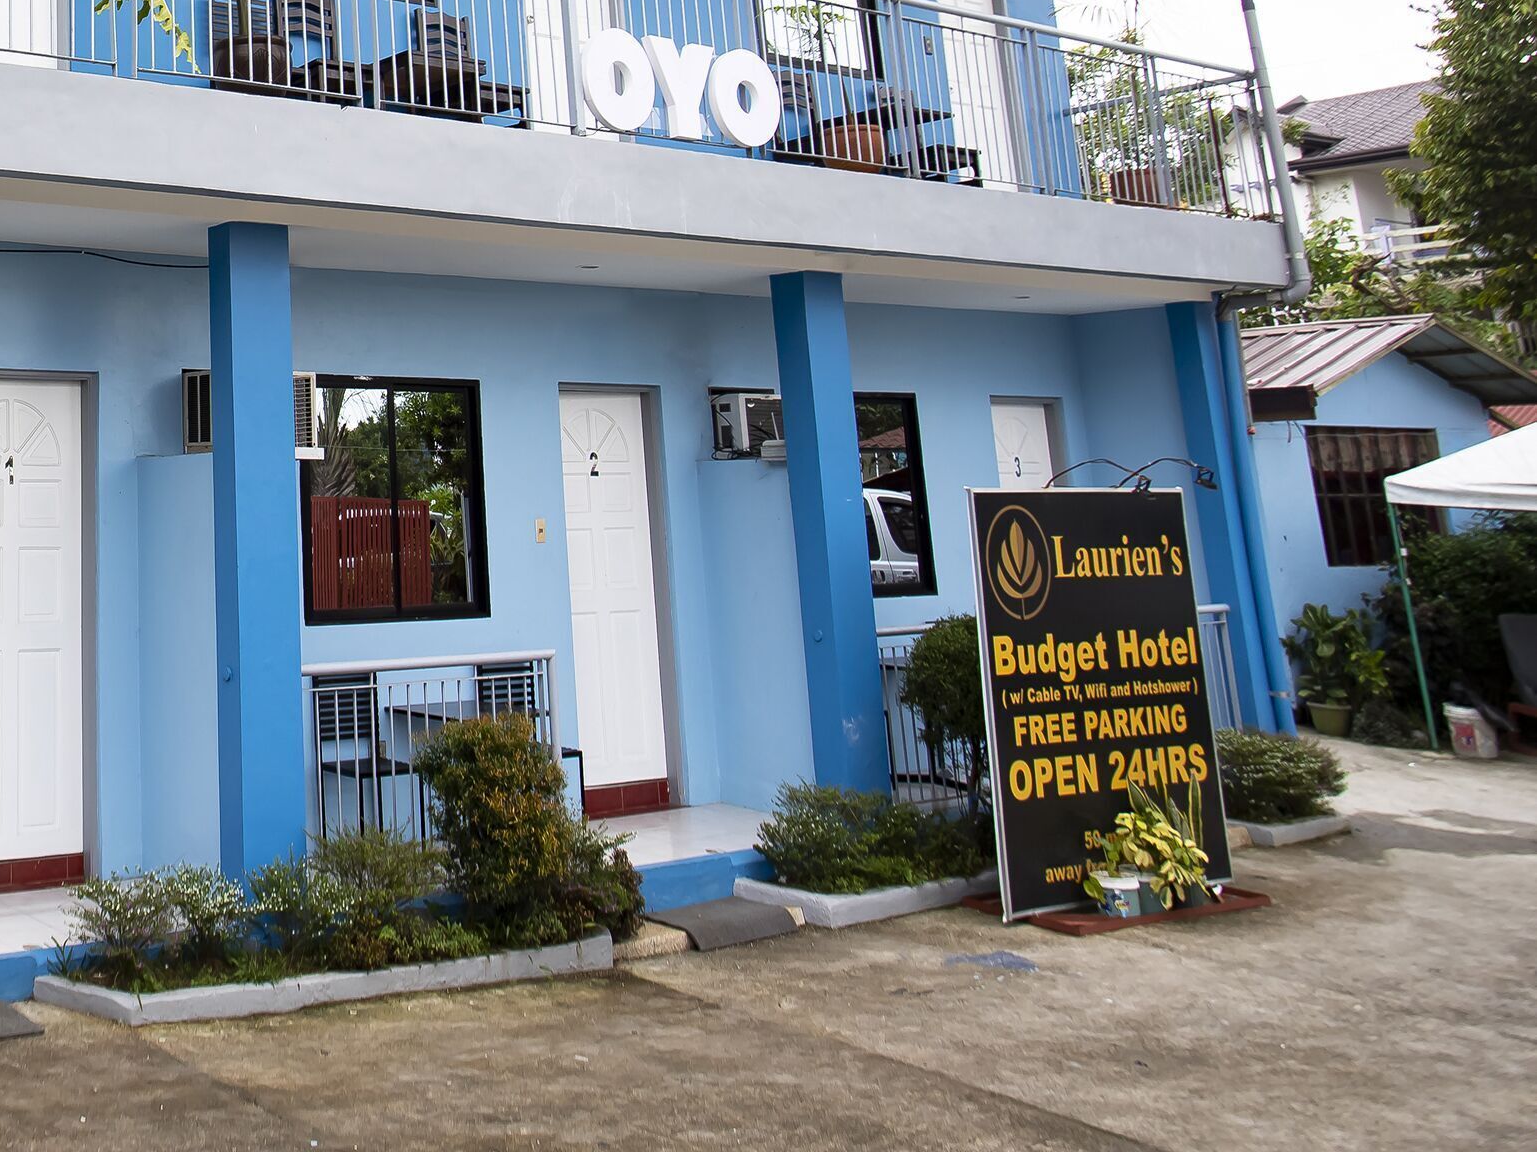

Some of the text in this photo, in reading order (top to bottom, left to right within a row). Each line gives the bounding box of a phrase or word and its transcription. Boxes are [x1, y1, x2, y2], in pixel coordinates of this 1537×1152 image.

[581, 27, 781, 148] OYO
[589, 451, 600, 477] 2
[1014, 456, 1022, 478] 3
[1051, 535, 1183, 577] Laurien's
[993, 627, 1197, 682] Budget Hotel
[1026, 686, 1061, 704] Cable
[1063, 685, 1083, 703] TV,
[1084, 682, 1107, 700] Wifi
[1110, 680, 1131, 697] and
[1133, 677, 1192, 696] Hotshower
[1014, 704, 1187, 747] FREE PARKING
[1009, 743, 1208, 801] OPEN 24HRS
[1045, 864, 1083, 884] away
